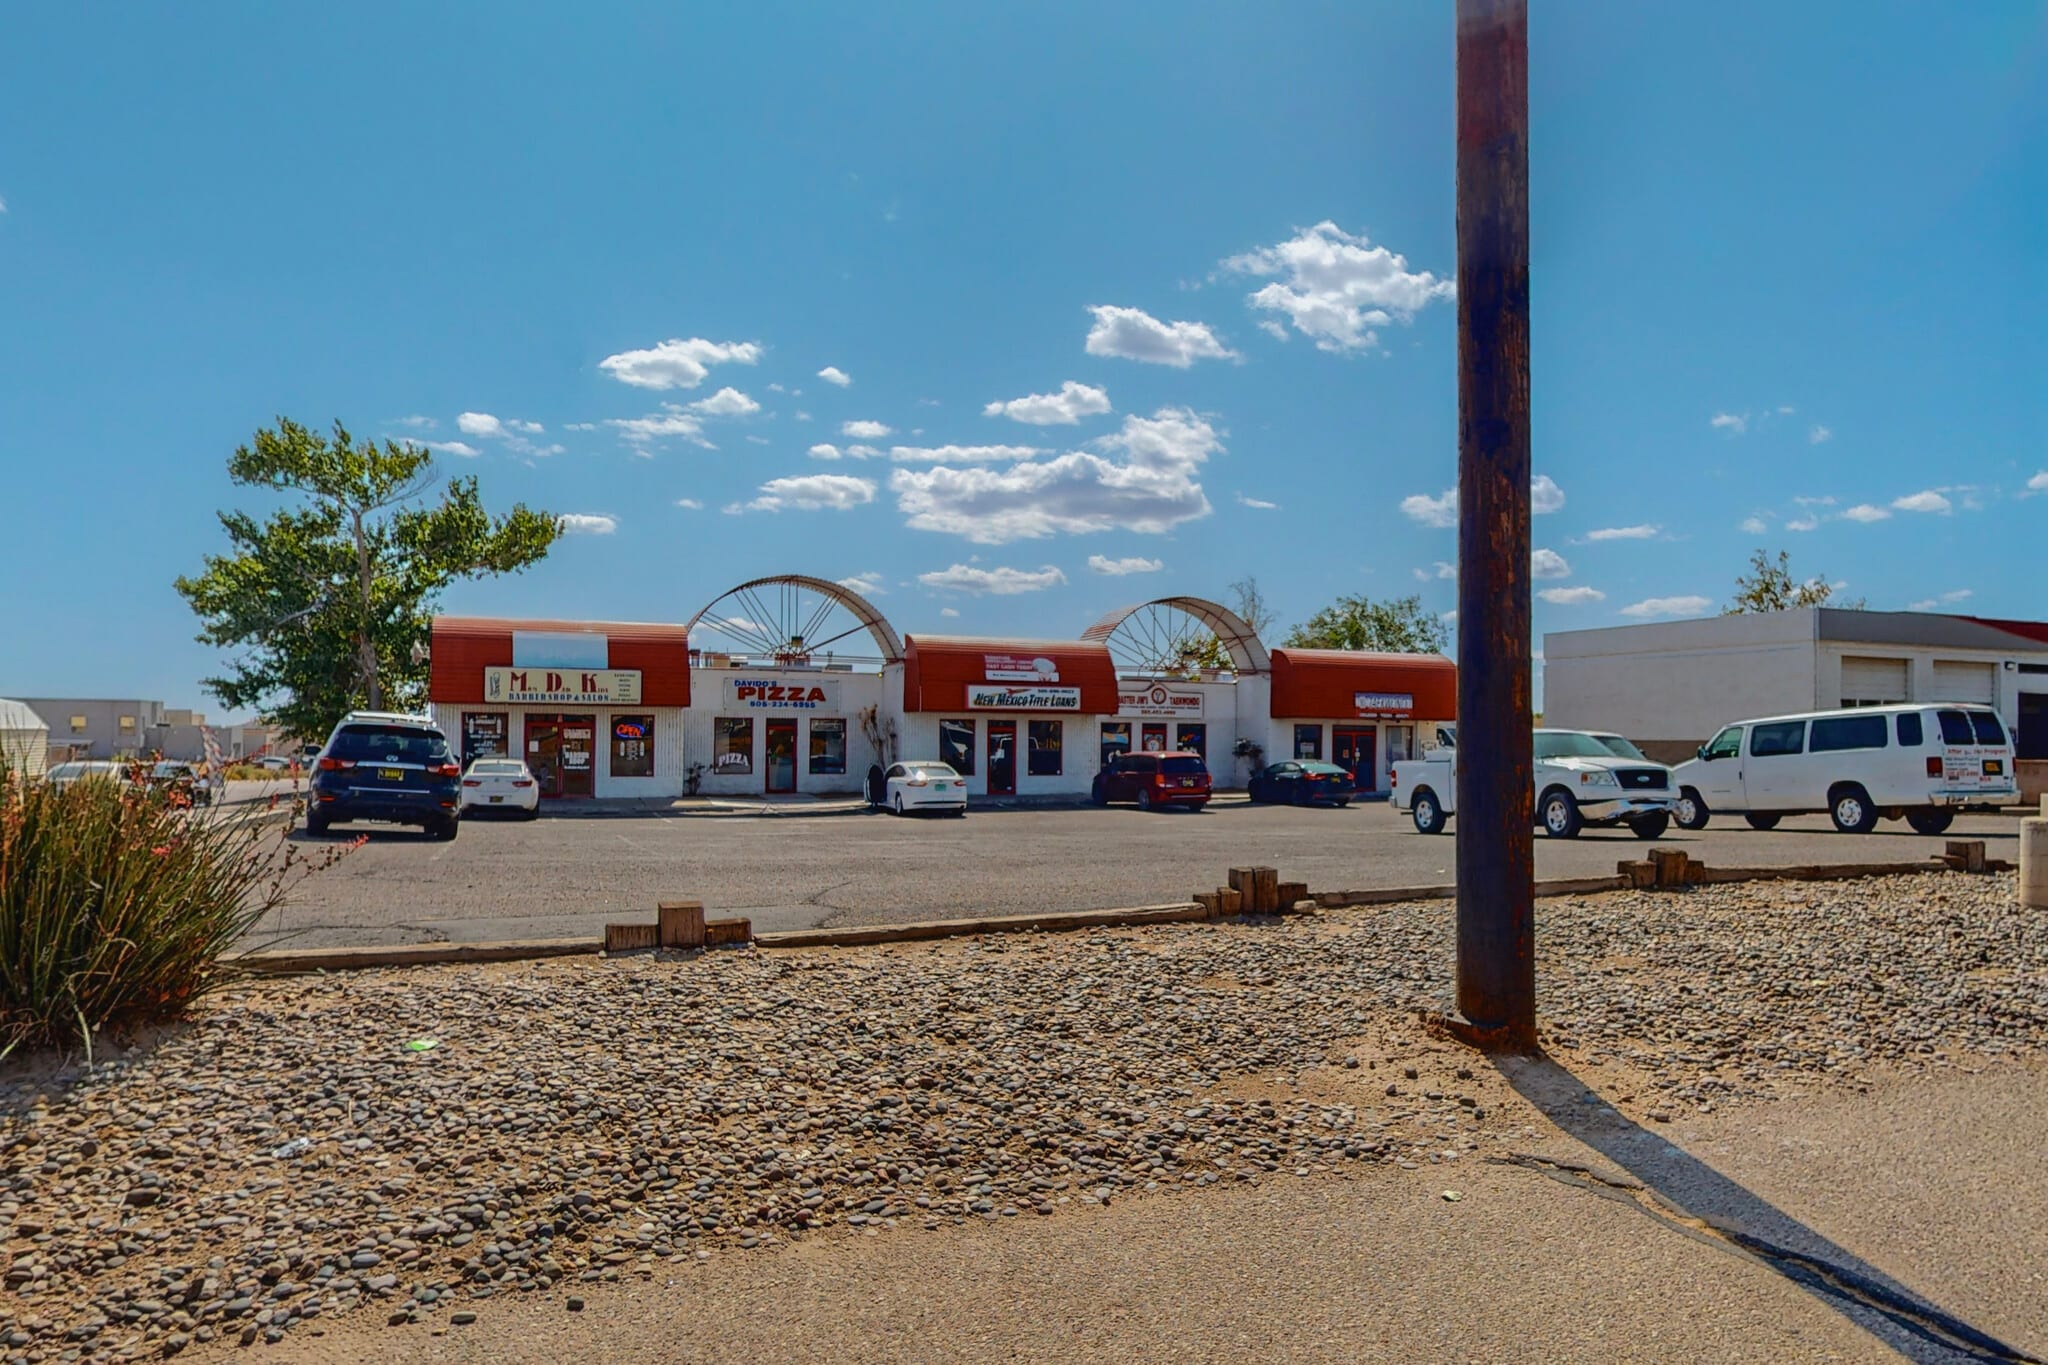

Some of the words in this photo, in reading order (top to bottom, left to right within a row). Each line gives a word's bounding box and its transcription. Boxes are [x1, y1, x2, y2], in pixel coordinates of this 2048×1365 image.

[738, 687, 826, 702] PIZZA
[616, 723, 641, 738] OPEN
[718, 752, 749, 768] PIZZA
